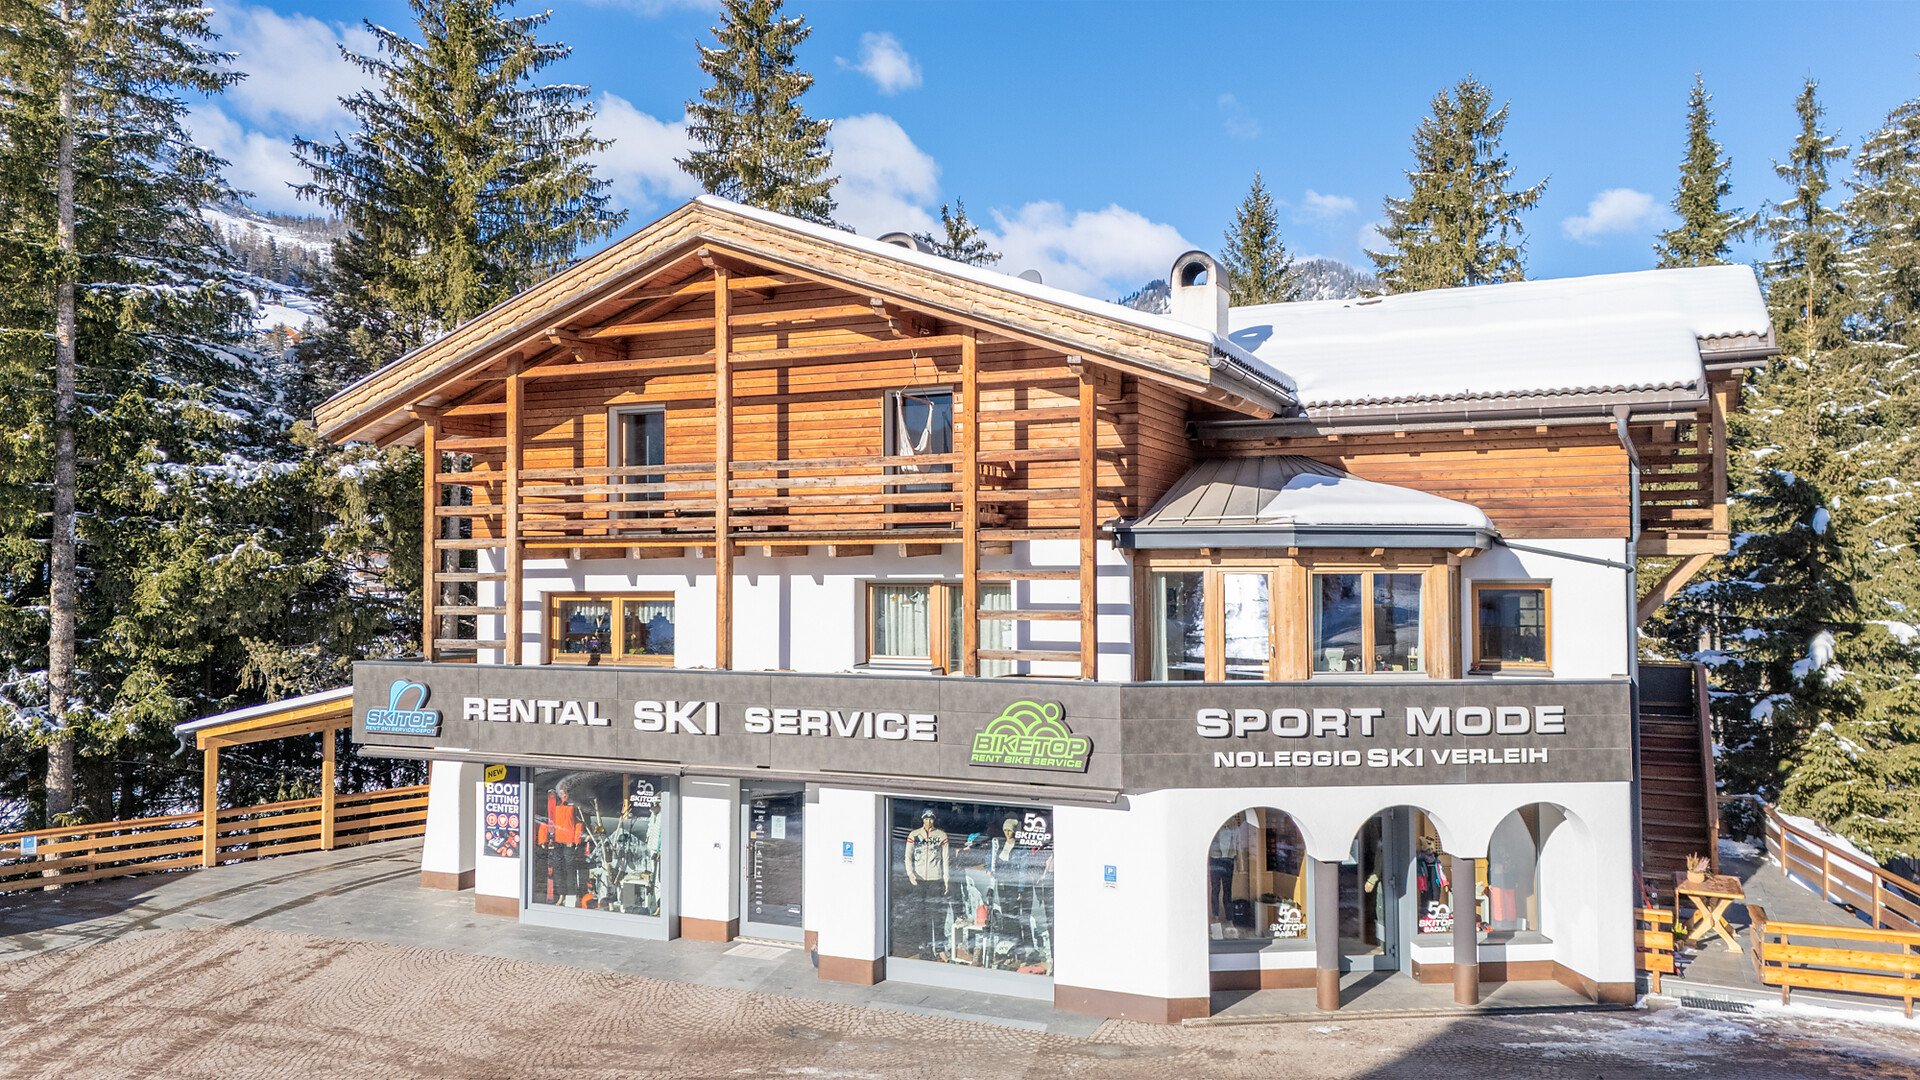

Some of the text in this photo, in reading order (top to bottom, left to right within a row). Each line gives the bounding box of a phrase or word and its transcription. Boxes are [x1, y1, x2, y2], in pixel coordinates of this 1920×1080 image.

[366, 708, 438, 728] SKITOP
[463, 697, 939, 743] RENTAL SKI SERVICE
[1196, 705, 1566, 739] SPORT MODE
[972, 733, 1088, 759] BIKETOP
[971, 754, 1083, 768] RENT BIKE SERVICE
[1213, 748, 1549, 768] NOLEGGIO SKI VERLEIH
[488, 768, 504, 778] NEW
[486, 783, 519, 795] BOOT
[636, 780, 654, 796] 50
[486, 794, 519, 804] FITTING
[630, 795, 658, 803] SKITOP
[486, 803, 519, 814] CENTER
[1023, 813, 1046, 832] 50
[1015, 831, 1051, 841] SKITOP
[1278, 903, 1301, 923] 50
[1427, 901, 1450, 919] 50
[1270, 923, 1306, 931] SKITOP
[1419, 919, 1454, 927] SKITOP
